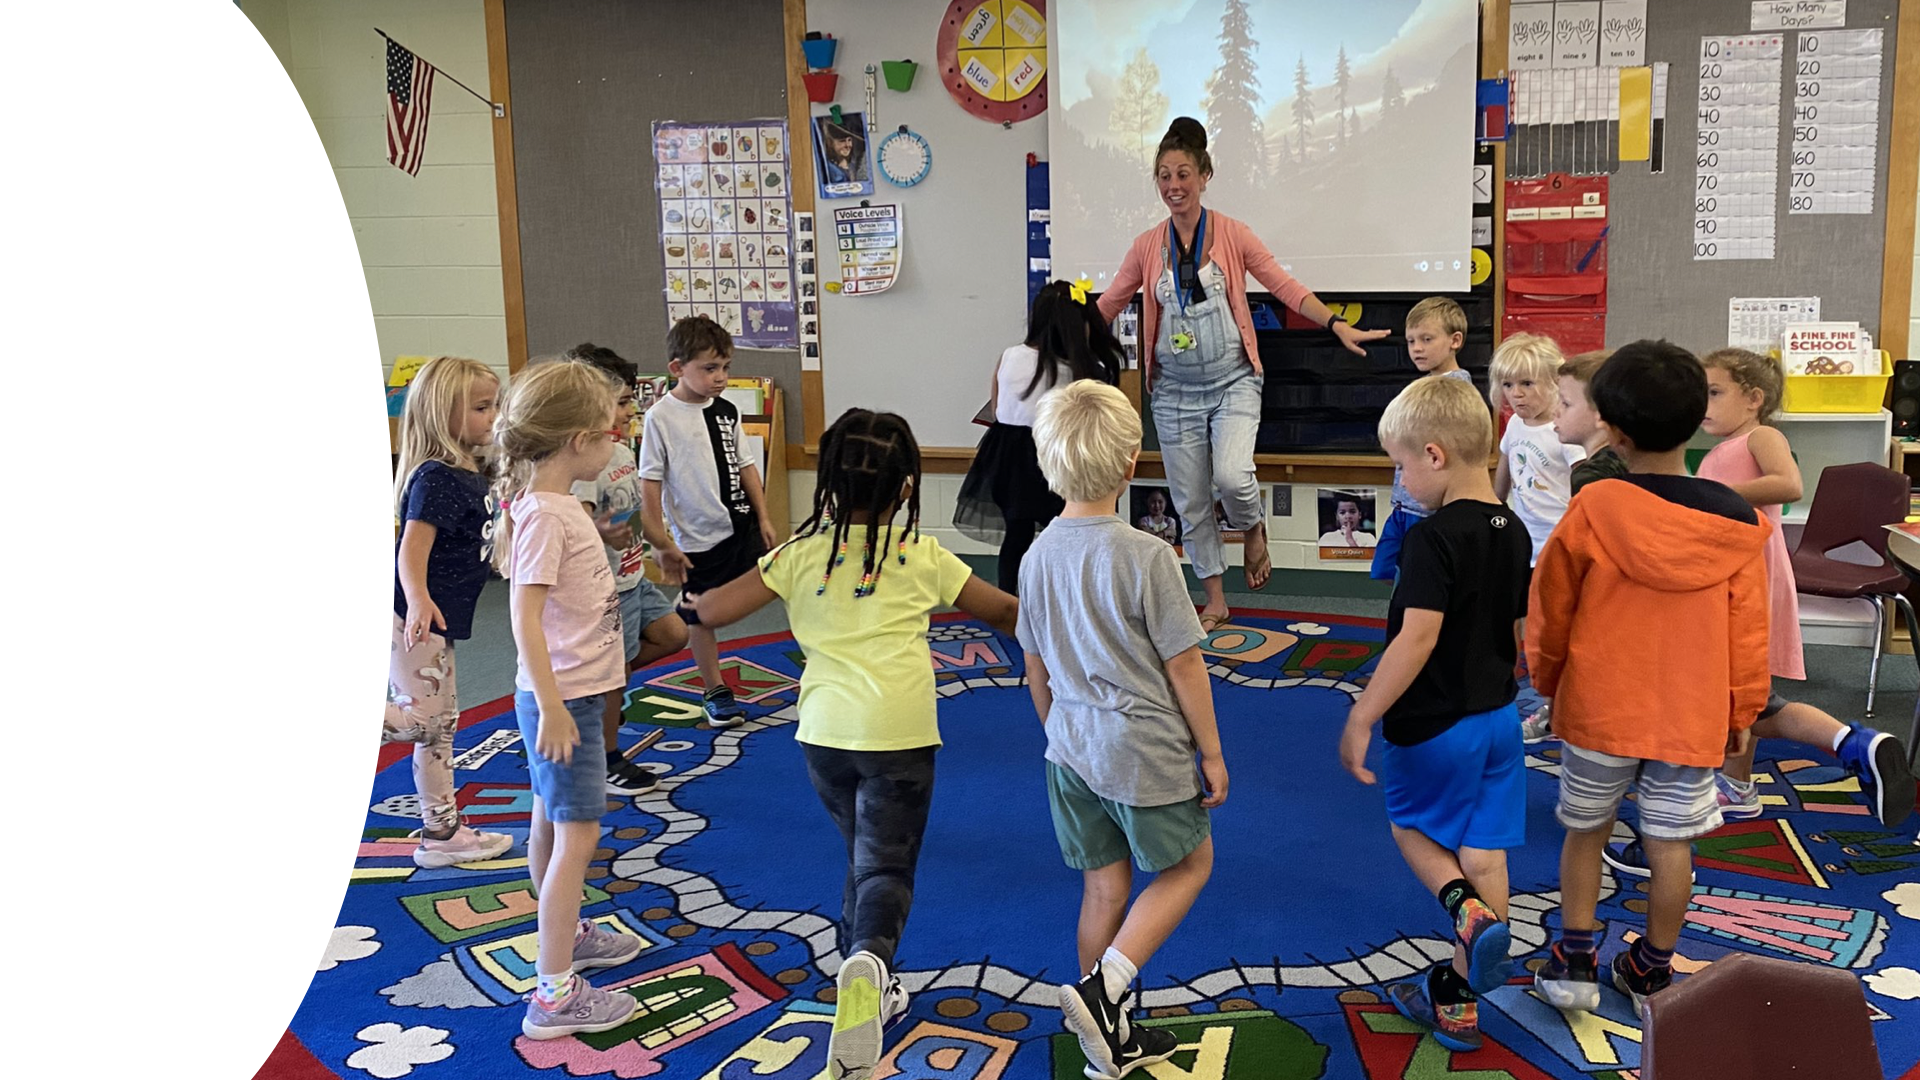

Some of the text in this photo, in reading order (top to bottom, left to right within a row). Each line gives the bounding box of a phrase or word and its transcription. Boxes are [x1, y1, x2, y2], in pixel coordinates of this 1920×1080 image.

[1770, 2, 1827, 14] How Many
[968, 8, 990, 42] green
[1781, 15, 1815, 27] Days?
[1703, 40, 1720, 58] 10
[1800, 36, 1818, 52] 110
[1517, 54, 1536, 62] eight
[966, 62, 990, 88] blue
[1014, 60, 1033, 85] red
[1700, 64, 1722, 79] 20
[1796, 61, 1820, 75] 120
[1700, 86, 1721, 101] 30
[1795, 82, 1820, 97] 130
[1699, 109, 1720, 124] 40
[1794, 106, 1818, 120] 140
[1698, 131, 1720, 146] 50
[1793, 126, 1818, 142] 150
[1697, 153, 1719, 168] 60
[1791, 151, 1816, 165] 160
[1552, 175, 1562, 189] 6
[1697, 175, 1718, 190] 70
[1790, 172, 1815, 187] 170
[1696, 197, 1717, 212] 80
[1789, 197, 1813, 210] 180
[839, 208, 891, 219] Voice Levels
[1696, 219, 1717, 234] 90
[1694, 242, 1717, 256] 100
[845, 254, 850, 262] 2
[1340, 304, 1347, 317] 7
[1260, 314, 1268, 326] 5
[1790, 341, 1856, 350] SCHOOL
[1301, 642, 1371, 669] P
